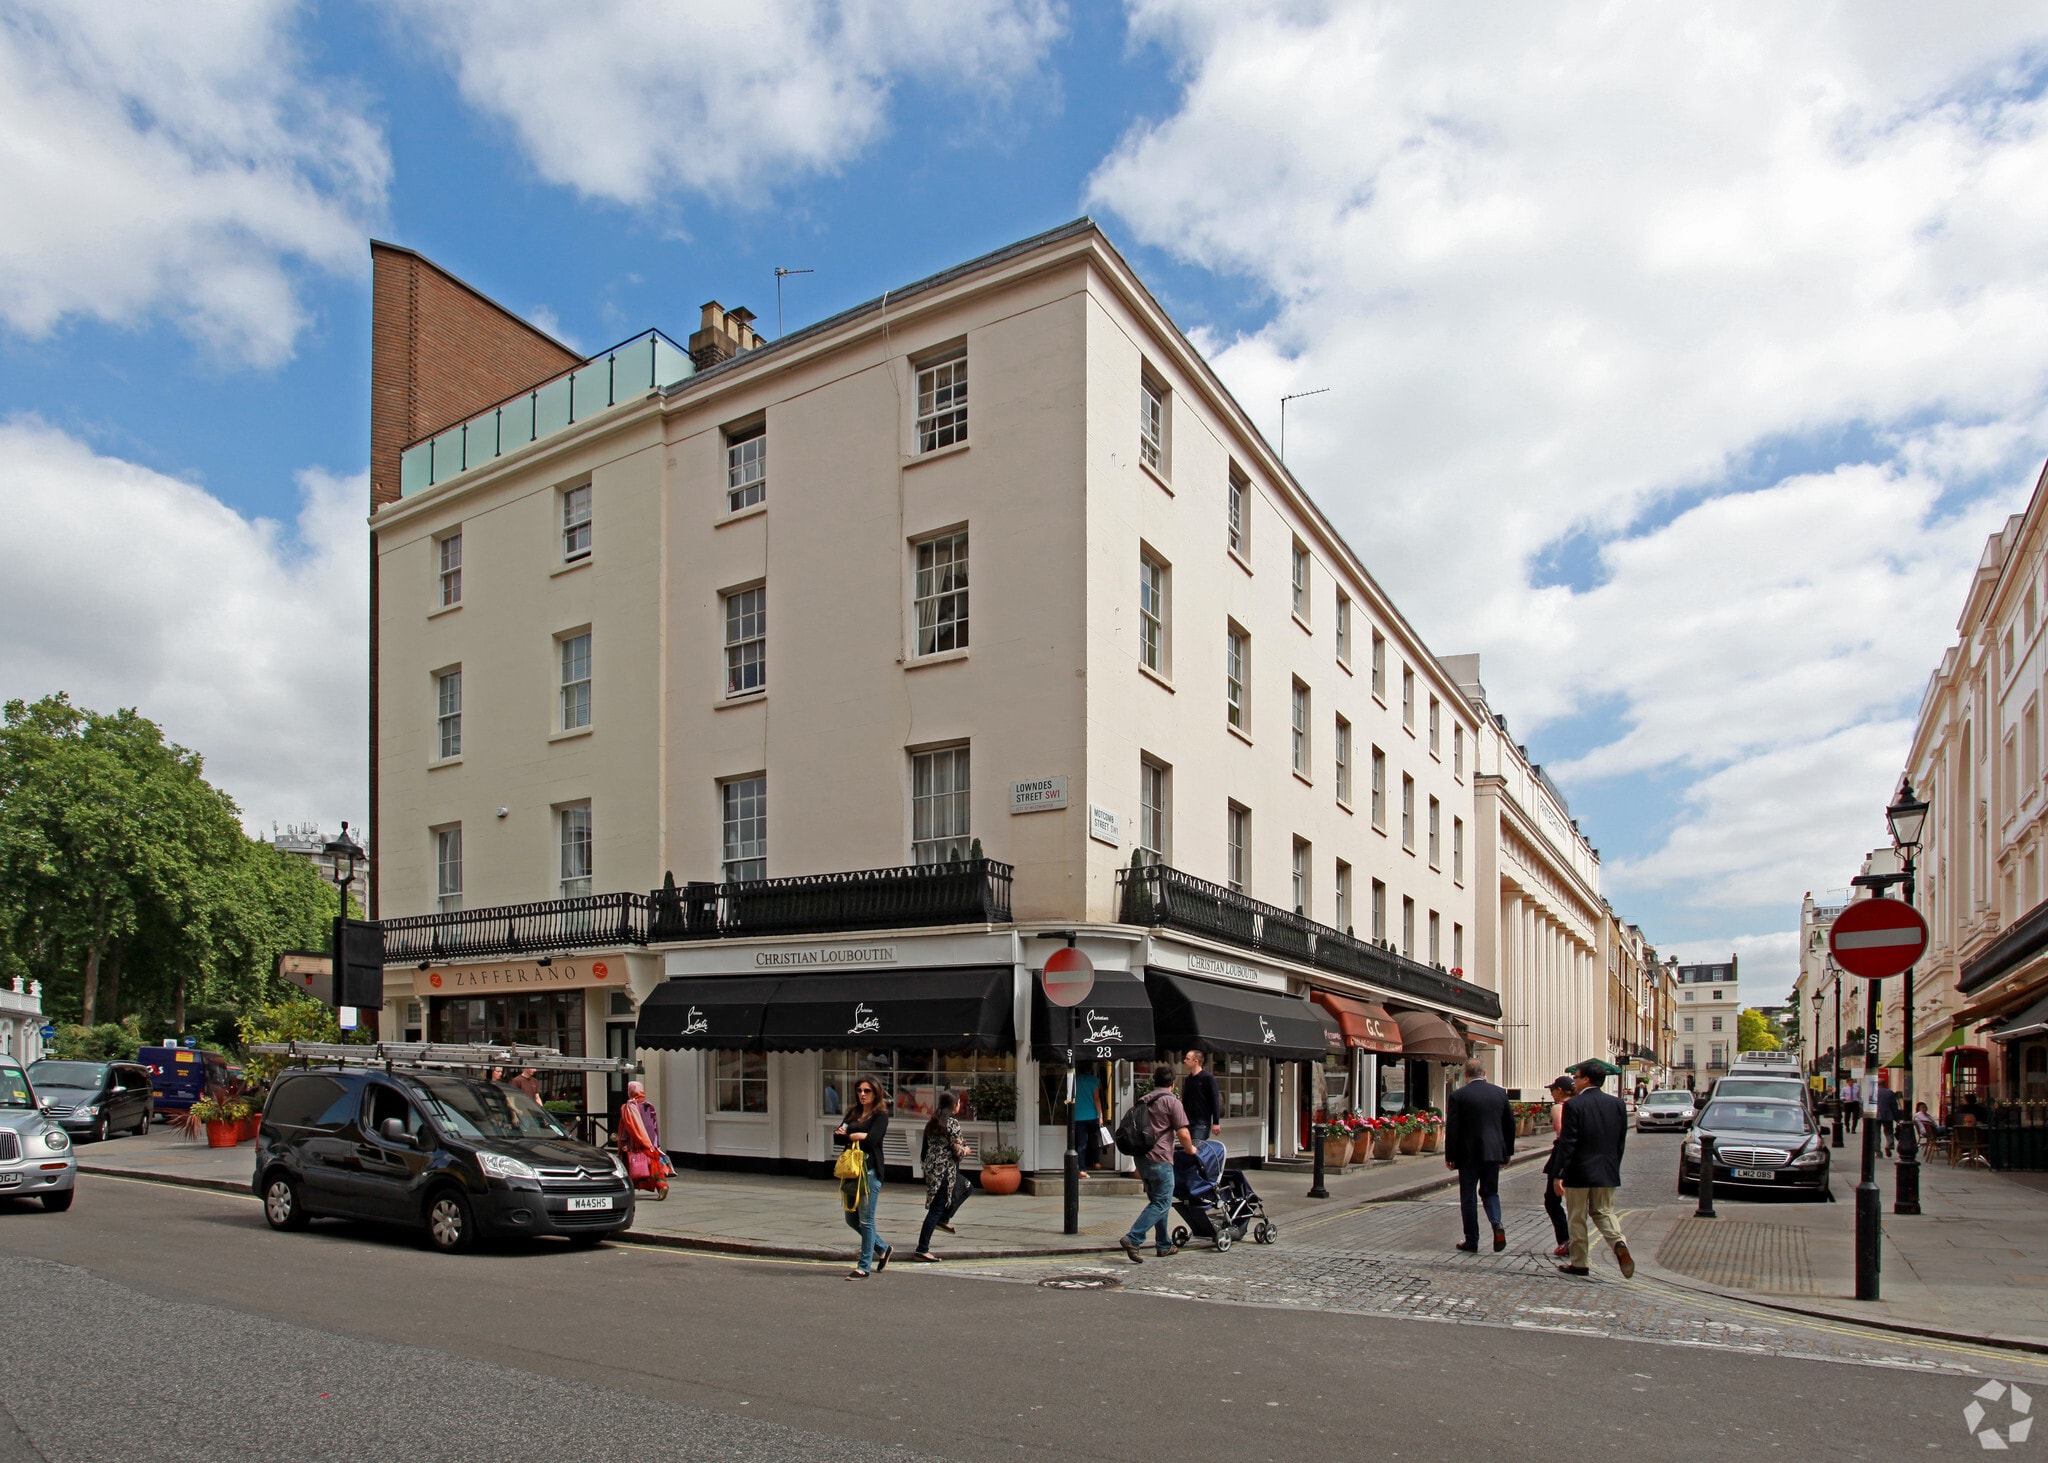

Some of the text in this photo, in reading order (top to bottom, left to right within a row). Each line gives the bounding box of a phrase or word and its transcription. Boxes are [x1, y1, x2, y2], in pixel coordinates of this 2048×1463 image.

[1016, 780, 1053, 793] LOWNDES
[1016, 790, 1060, 803] STREET SW1
[1094, 808, 1114, 824] MOTCOMB
[1094, 818, 1119, 836] STREET SW1
[756, 948, 893, 966] CHRISTIAN LOUBOUTIN
[455, 965, 577, 986] ZAFFERANO
[1191, 955, 1258, 980] CHRISTIAN LOUBOUTIN
[1096, 1046, 1112, 1058] 23
[1756, 1171, 1772, 1179] OBS
